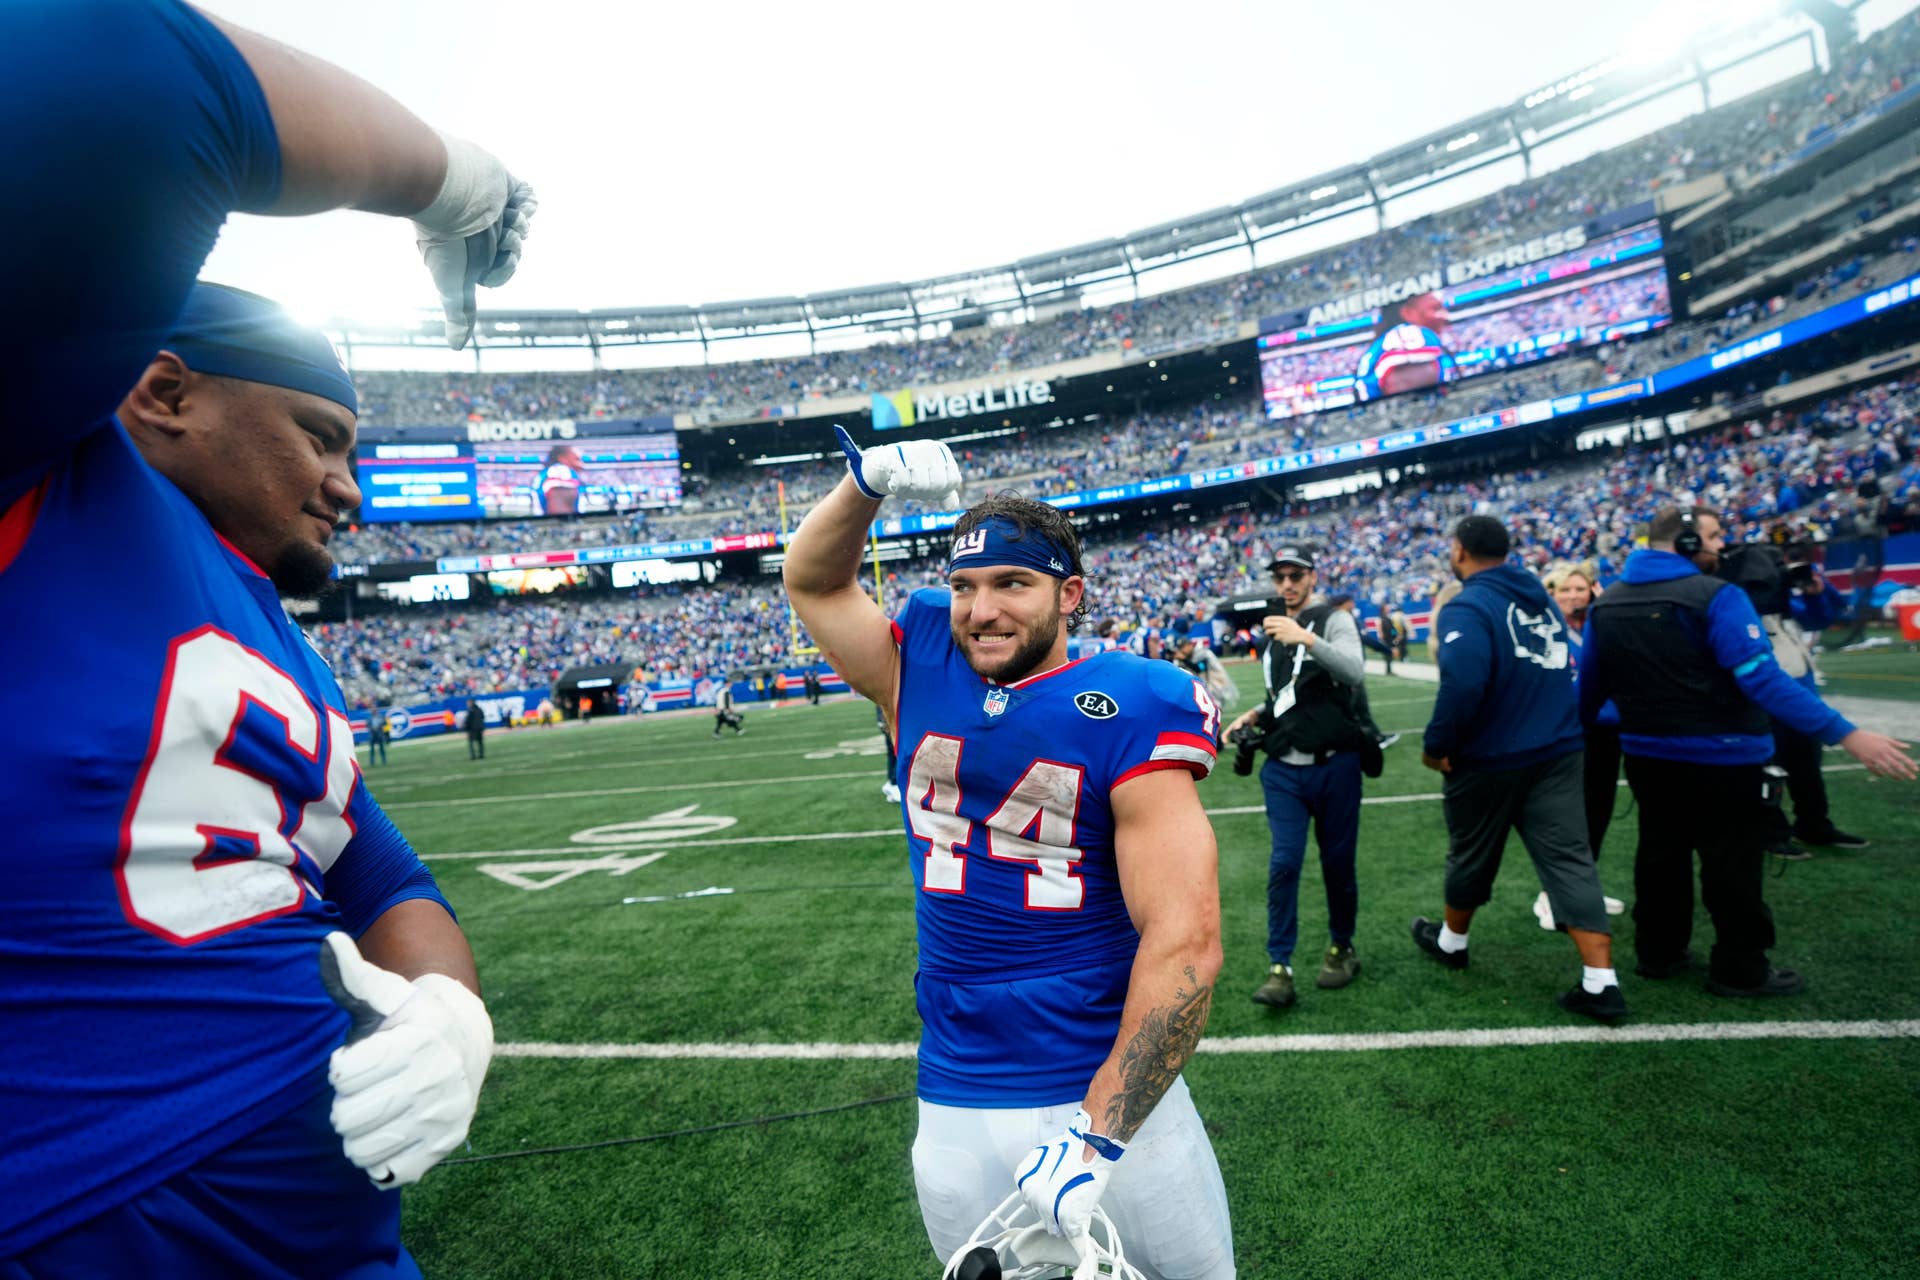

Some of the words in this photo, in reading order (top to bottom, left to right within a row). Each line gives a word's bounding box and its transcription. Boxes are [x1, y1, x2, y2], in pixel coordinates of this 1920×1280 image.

[1307, 271, 1442, 325] AMERICAN
[1446, 226, 1588, 284] EXPRESS
[917, 379, 1051, 421] MetLife
[468, 419, 577, 442] MOODY'S
[987, 700, 1002, 712] NFL
[1082, 695, 1109, 715] EA
[1192, 679, 1222, 736] 4
[907, 731, 1086, 912] 44
